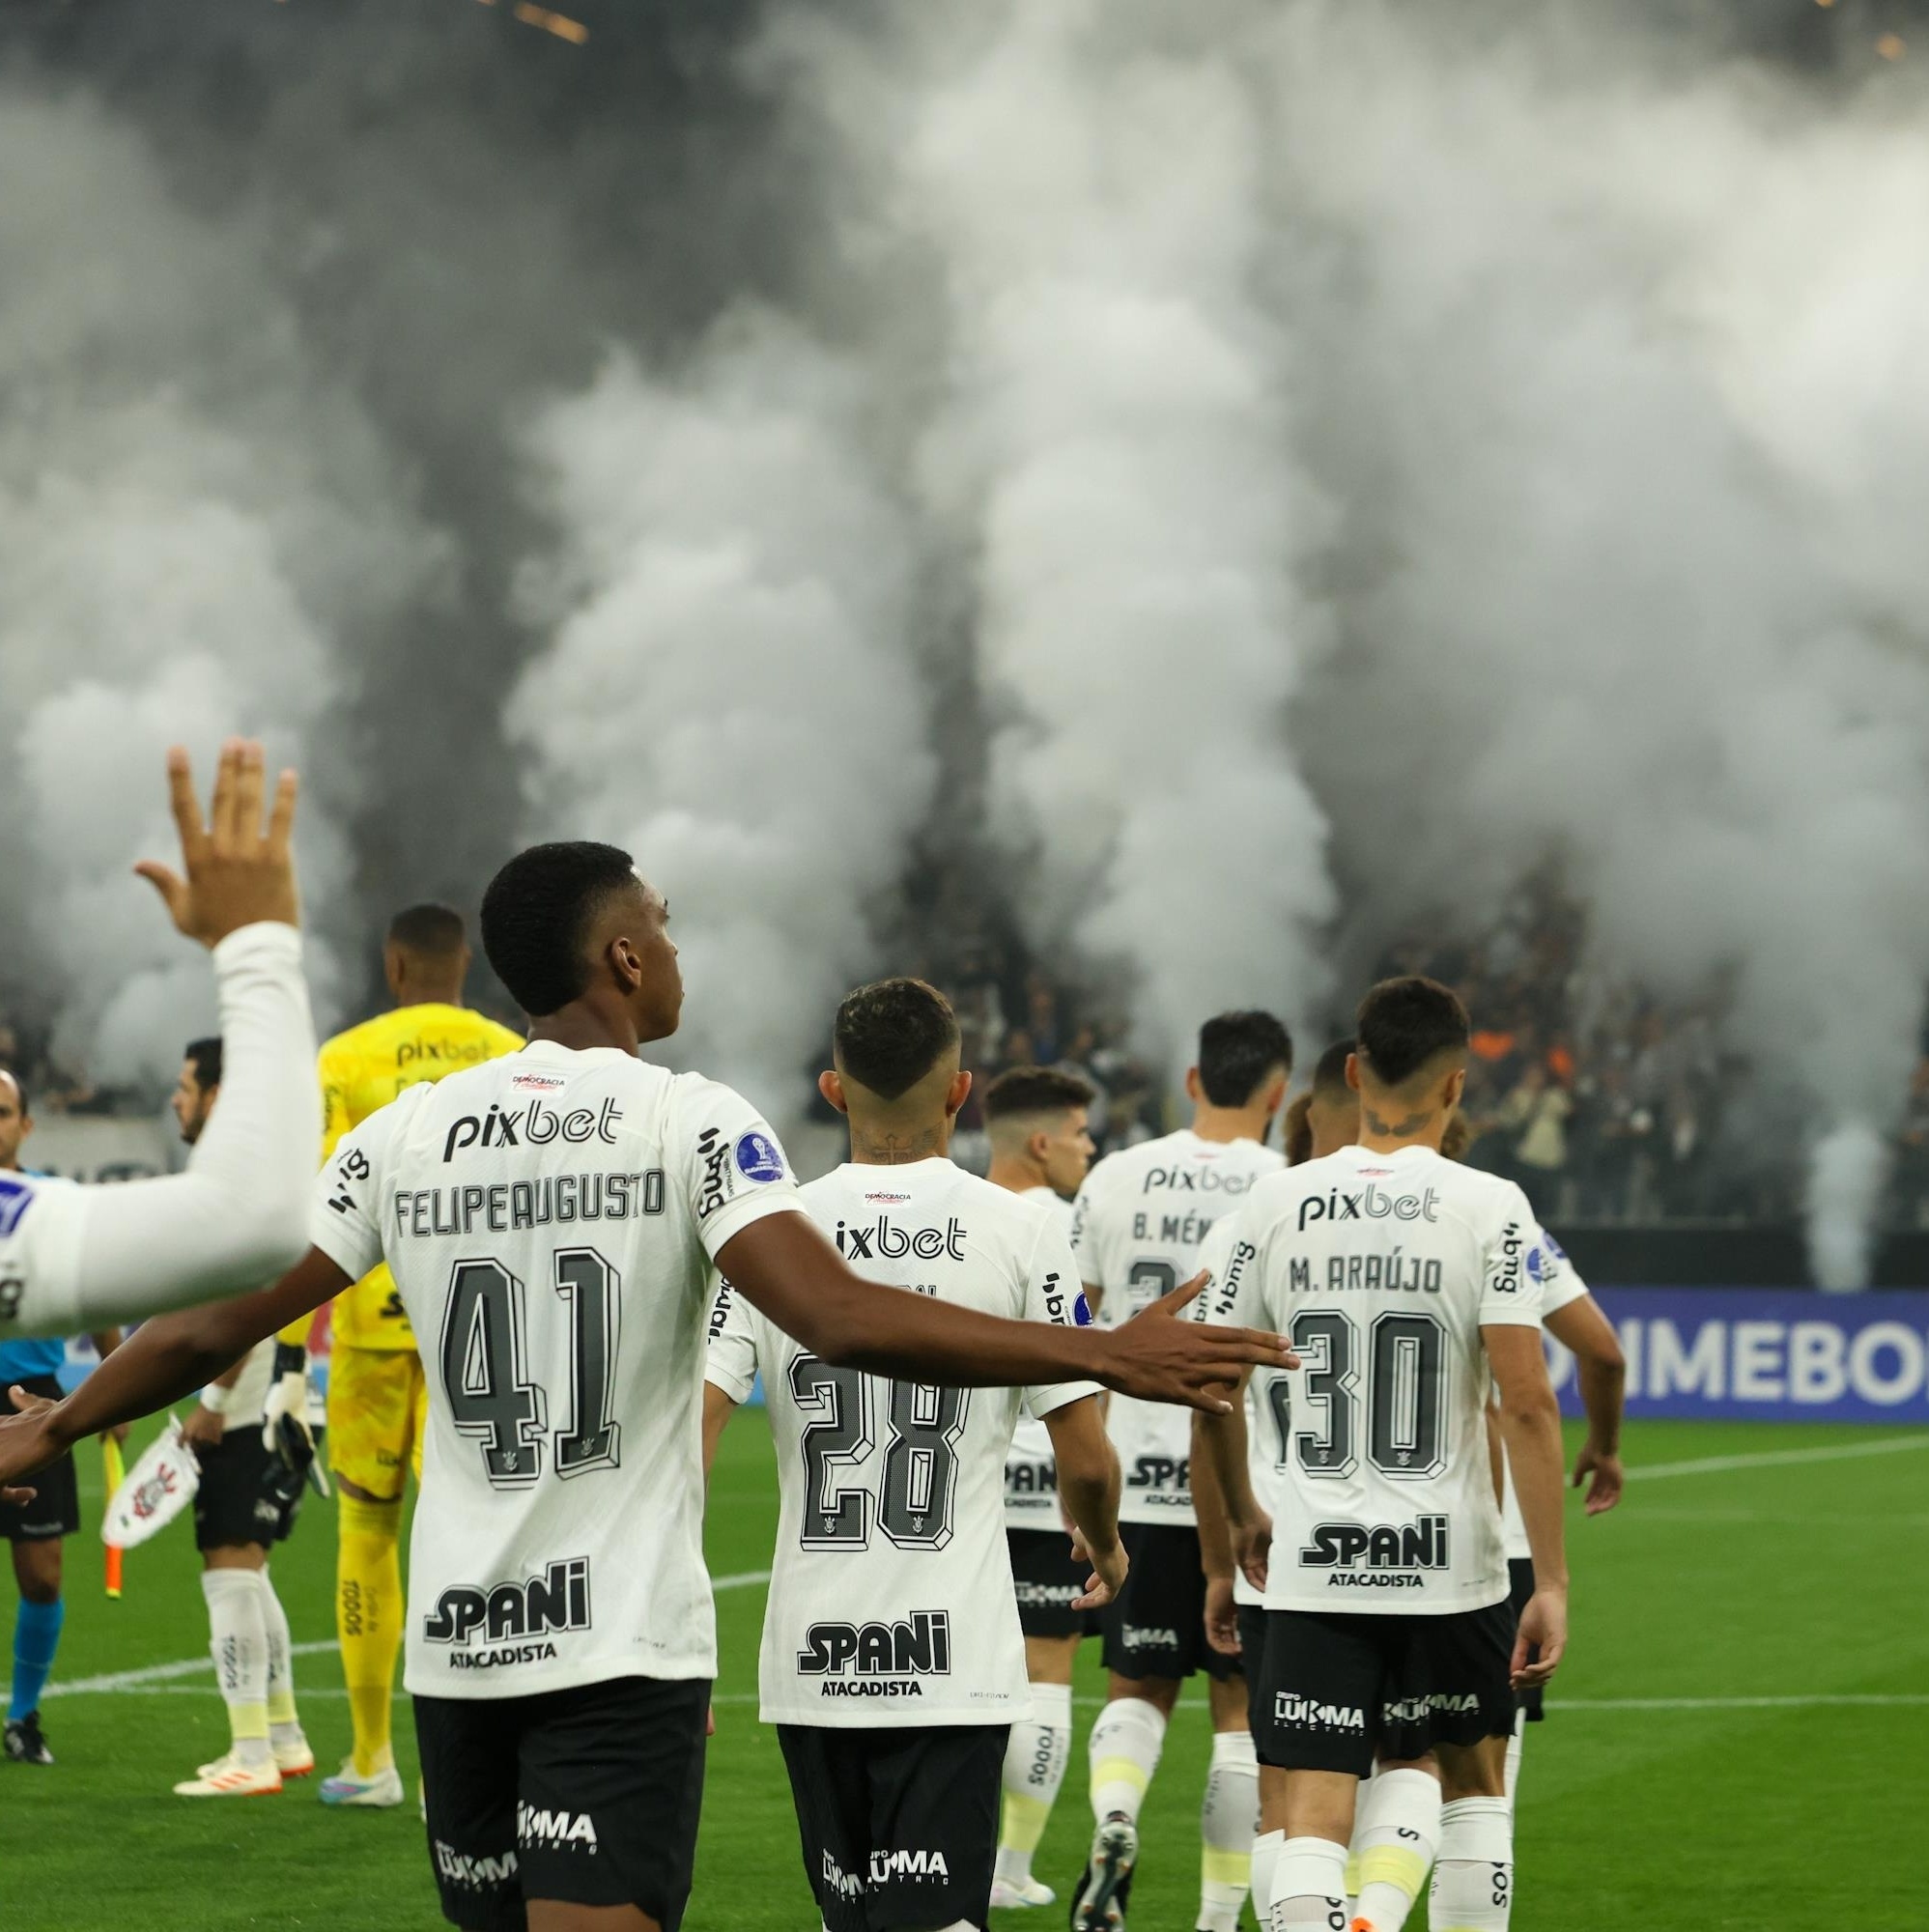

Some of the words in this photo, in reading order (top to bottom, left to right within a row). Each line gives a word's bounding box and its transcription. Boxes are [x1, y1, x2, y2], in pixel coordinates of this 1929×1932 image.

[442, 1097, 624, 1163] pixbet
[1297, 1183, 1441, 1233] pixbet
[1220, 1240, 1257, 1300] bmg
[1290, 1256, 1319, 1293] M.
[1326, 1245, 1442, 1294] ARAÚJO
[1492, 1238, 1523, 1293] bmg
[439, 1246, 621, 1491] 41
[1289, 1309, 1451, 1480] 30
[787, 1352, 971, 1551] 28
[1327, 1573, 1425, 1588] ATACADISTA
[449, 1642, 557, 1669] ATACADISTA
[821, 1680, 922, 1696] ATACADISTA
